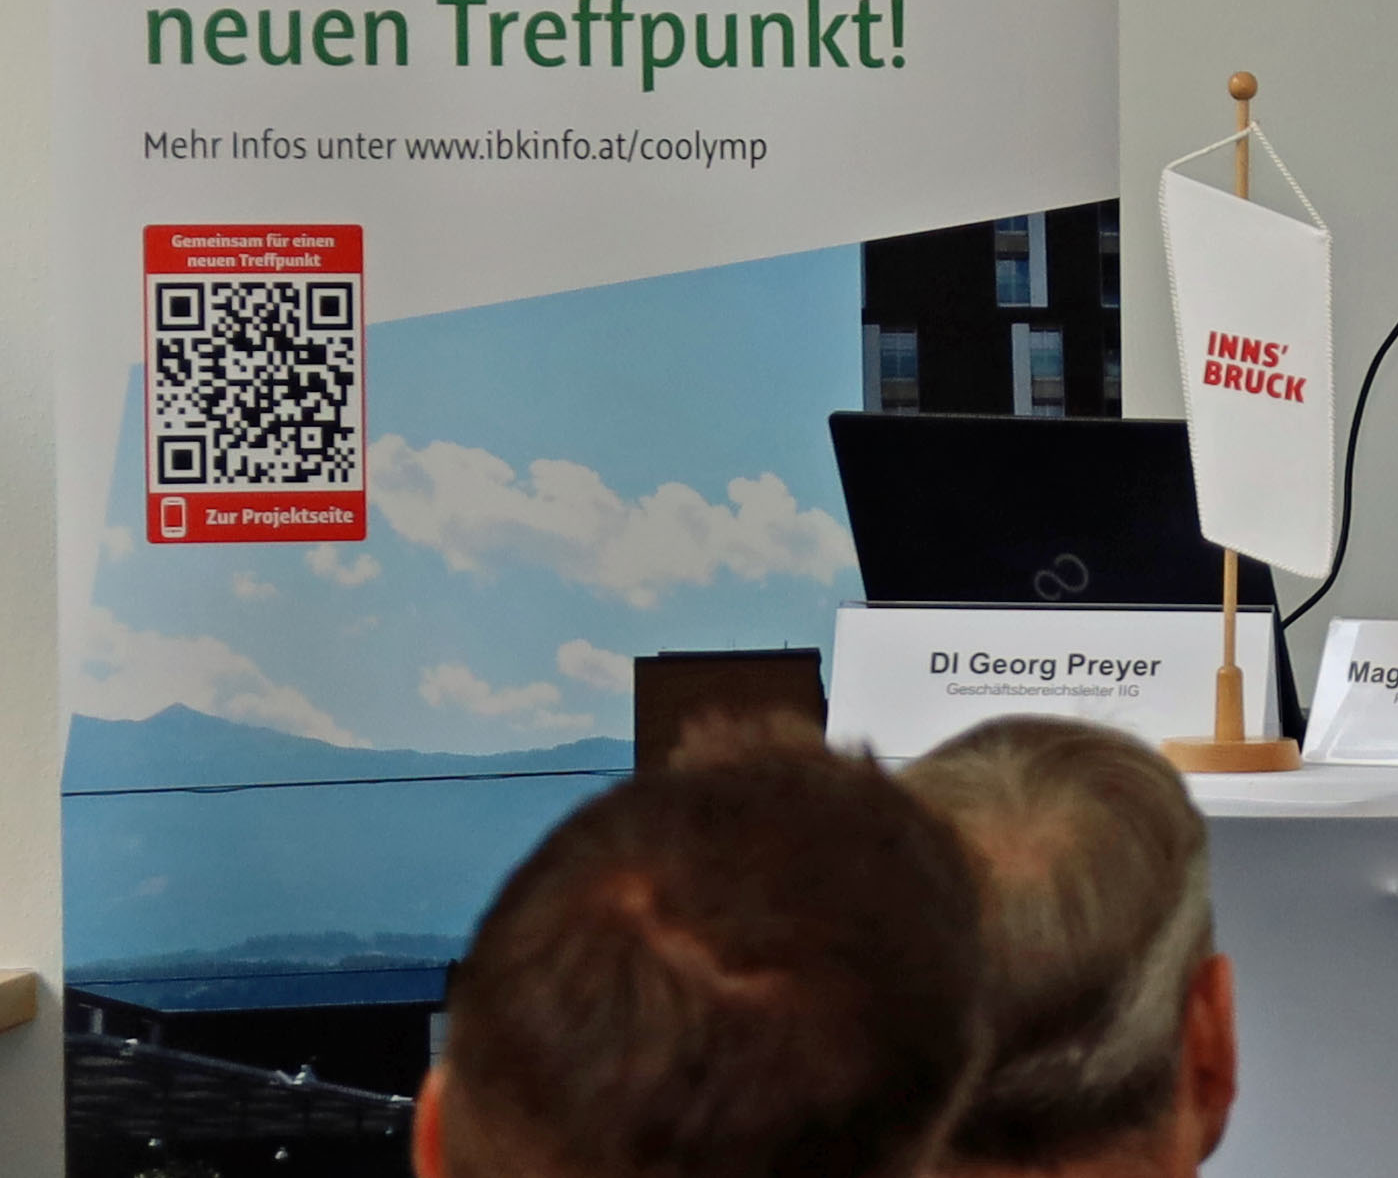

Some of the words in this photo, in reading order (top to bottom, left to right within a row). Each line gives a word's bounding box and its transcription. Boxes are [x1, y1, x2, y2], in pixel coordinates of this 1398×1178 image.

[146, 5, 408, 67] neuen
[143, 131, 224, 162] Mehr
[232, 131, 308, 162] Infos
[316, 134, 397, 163] unter
[404, 128, 769, 170] www.ibkinfo.at/coolymp
[171, 233, 265, 249] Gemeinsam
[265, 233, 289, 249] für
[292, 233, 336, 249] einen
[187, 254, 237, 268] neuen
[238, 252, 322, 271] Treffpunkt
[1206, 330, 1290, 368] INNS'
[1202, 359, 1308, 404] BRUCK
[205, 507, 238, 525] Zur
[240, 505, 354, 530] Projektseite
[929, 652, 958, 675] DI
[968, 652, 1058, 681] Georg
[1066, 653, 1163, 682] Preyer
[946, 683, 1115, 699] Geschäftsbereichsleiter
[1118, 684, 1140, 698] IIG
